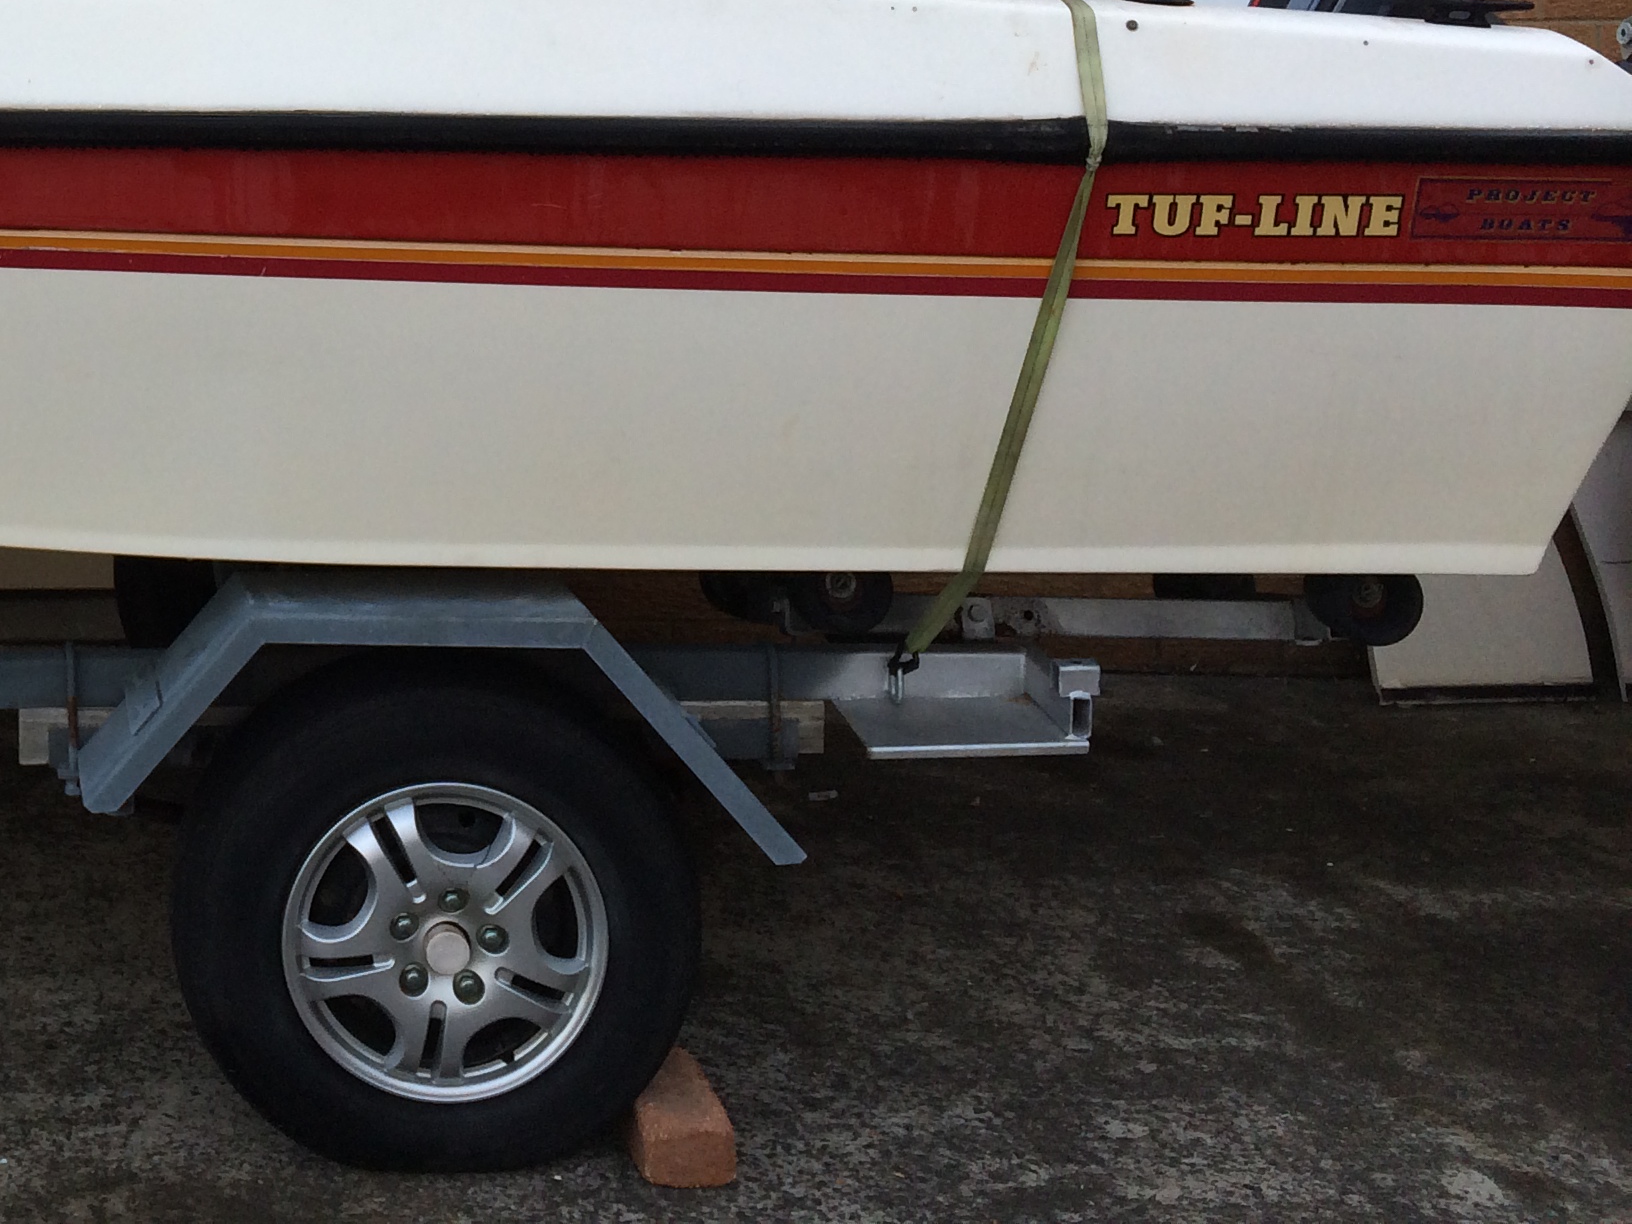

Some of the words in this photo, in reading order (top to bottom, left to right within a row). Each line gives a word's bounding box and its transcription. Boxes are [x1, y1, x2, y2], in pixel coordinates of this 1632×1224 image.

[1465, 188, 1597, 205] PROJECT
[1106, 193, 1405, 238] TUF-LINE
[1479, 218, 1573, 233] BOATS
